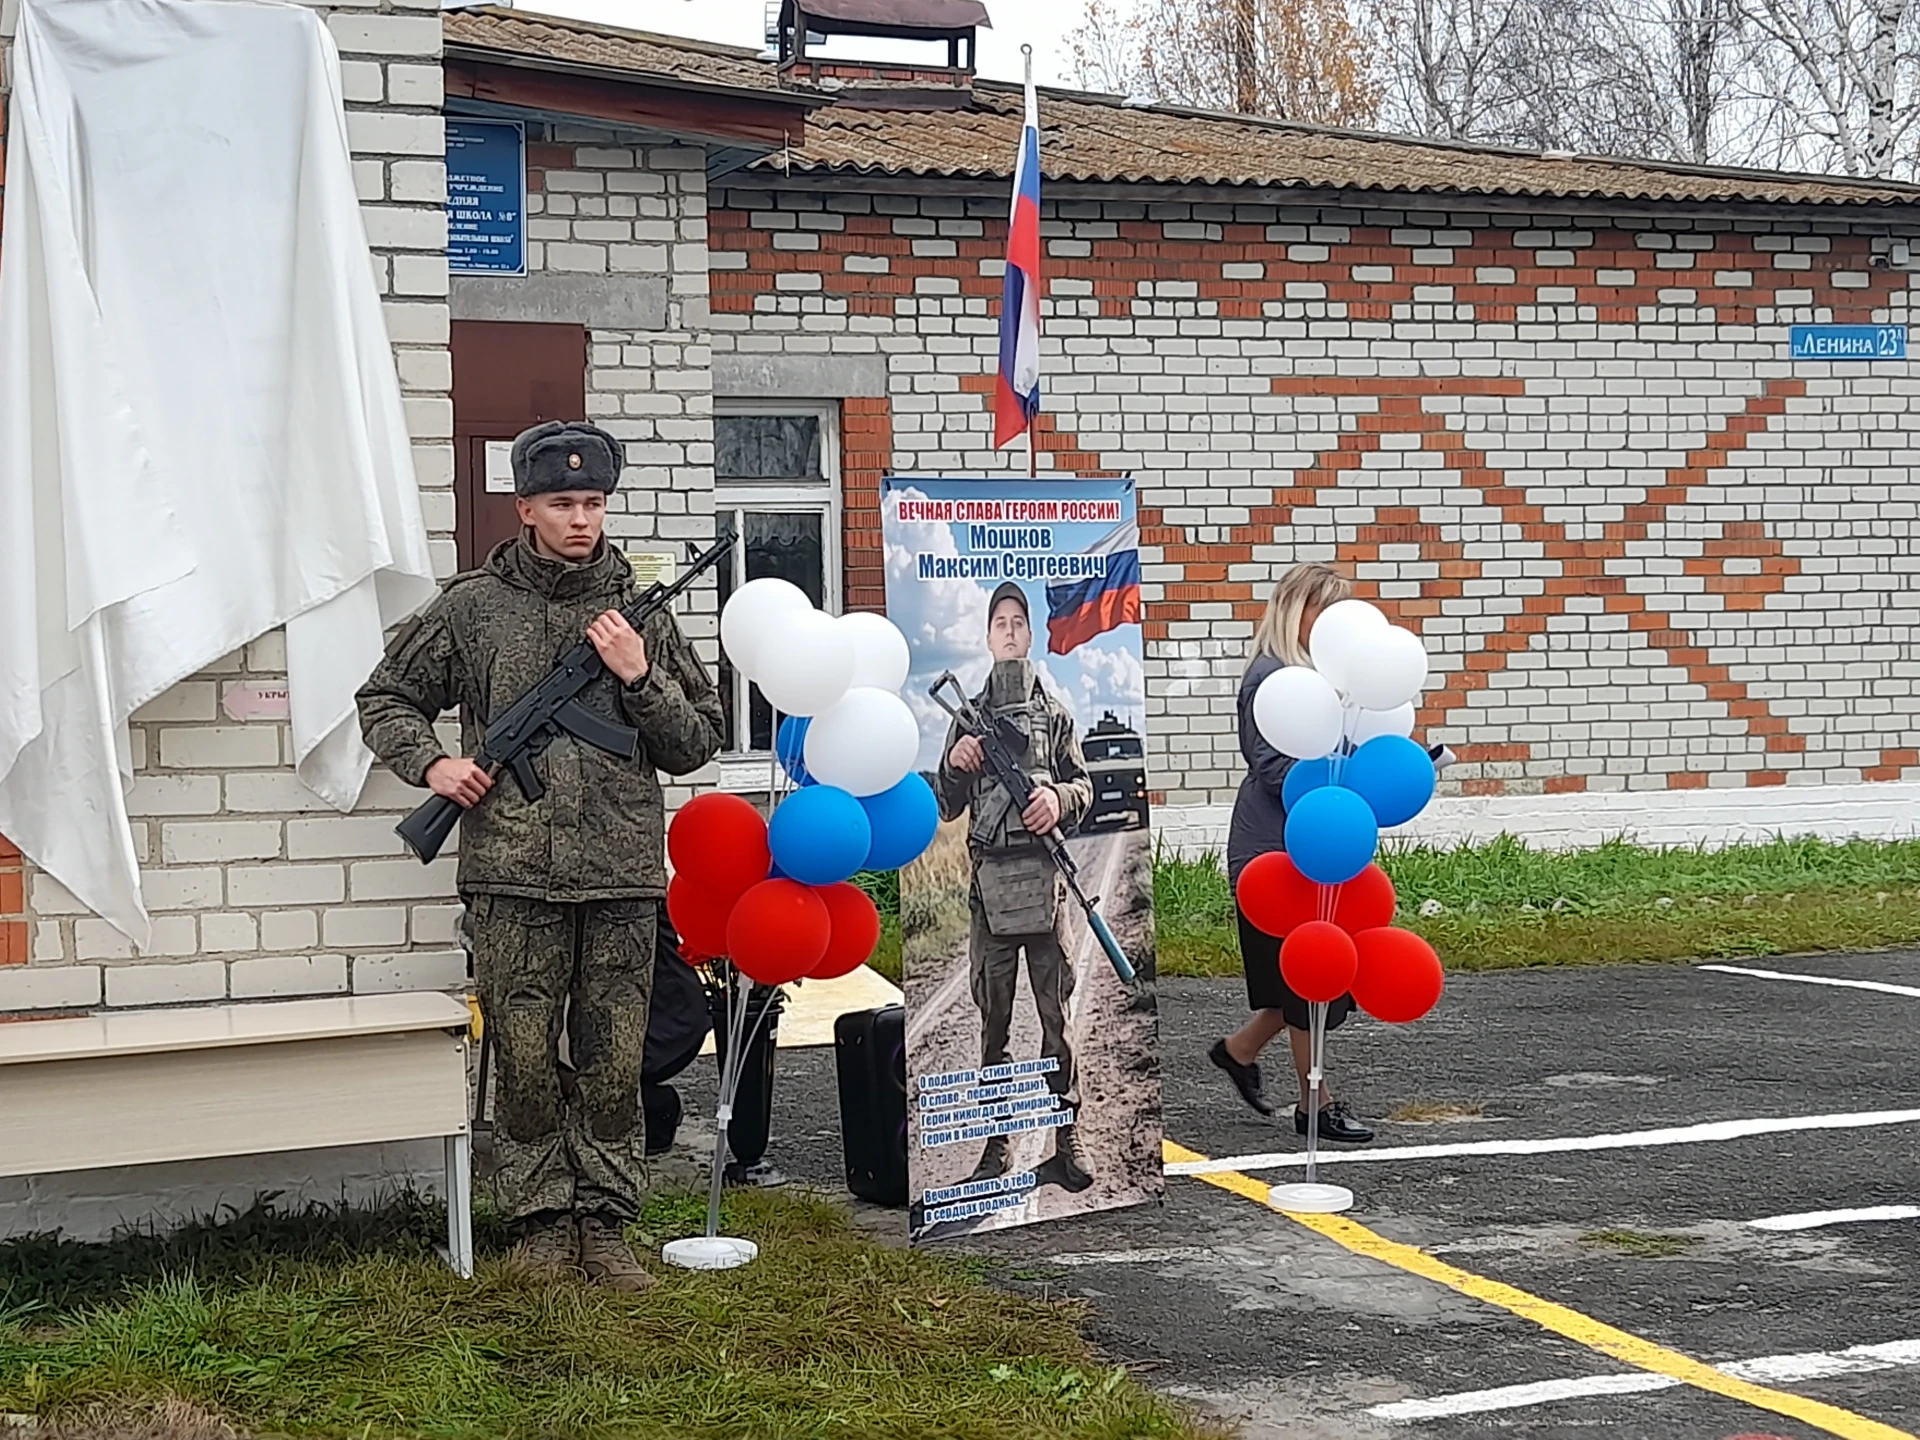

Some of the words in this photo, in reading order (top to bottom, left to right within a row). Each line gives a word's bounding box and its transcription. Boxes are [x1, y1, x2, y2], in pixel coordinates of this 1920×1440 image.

[456, 210, 493, 221] ШКОЛА
[1803, 333, 1874, 354] ЛЕНИНА
[900, 501, 952, 521] ВЕЧНАЯ
[956, 501, 1002, 521] СЛАВА
[1005, 501, 1058, 520] ГЕРОЯМ
[1061, 501, 1120, 520] РОССИИ!
[970, 525, 1052, 549] Мошков
[918, 553, 998, 578] Максим
[1002, 552, 1105, 580] Сергеевич
[920, 1076, 926, 1089] О
[928, 1070, 975, 1088] подвигах
[982, 1065, 1011, 1079] стихи
[921, 1095, 927, 1108] О
[929, 1092, 959, 1106] славе
[967, 1086, 998, 1100] песни
[921, 1112, 951, 1127] Герои
[953, 1105, 995, 1121] никогда
[997, 1103, 1009, 1114] не
[922, 1131, 952, 1146] Герои
[953, 1130, 960, 1140] в
[961, 1123, 996, 1139] нашей
[998, 1118, 1035, 1133] памяти
[1037, 1110, 1072, 1127] живут!
[924, 1187, 961, 1203] Вечная
[963, 1179, 1001, 1196] память
[1003, 1178, 1009, 1188] о
[1012, 1173, 1035, 1187] тебе
[926, 1210, 932, 1221] в
[934, 1203, 977, 1220] сердцах
